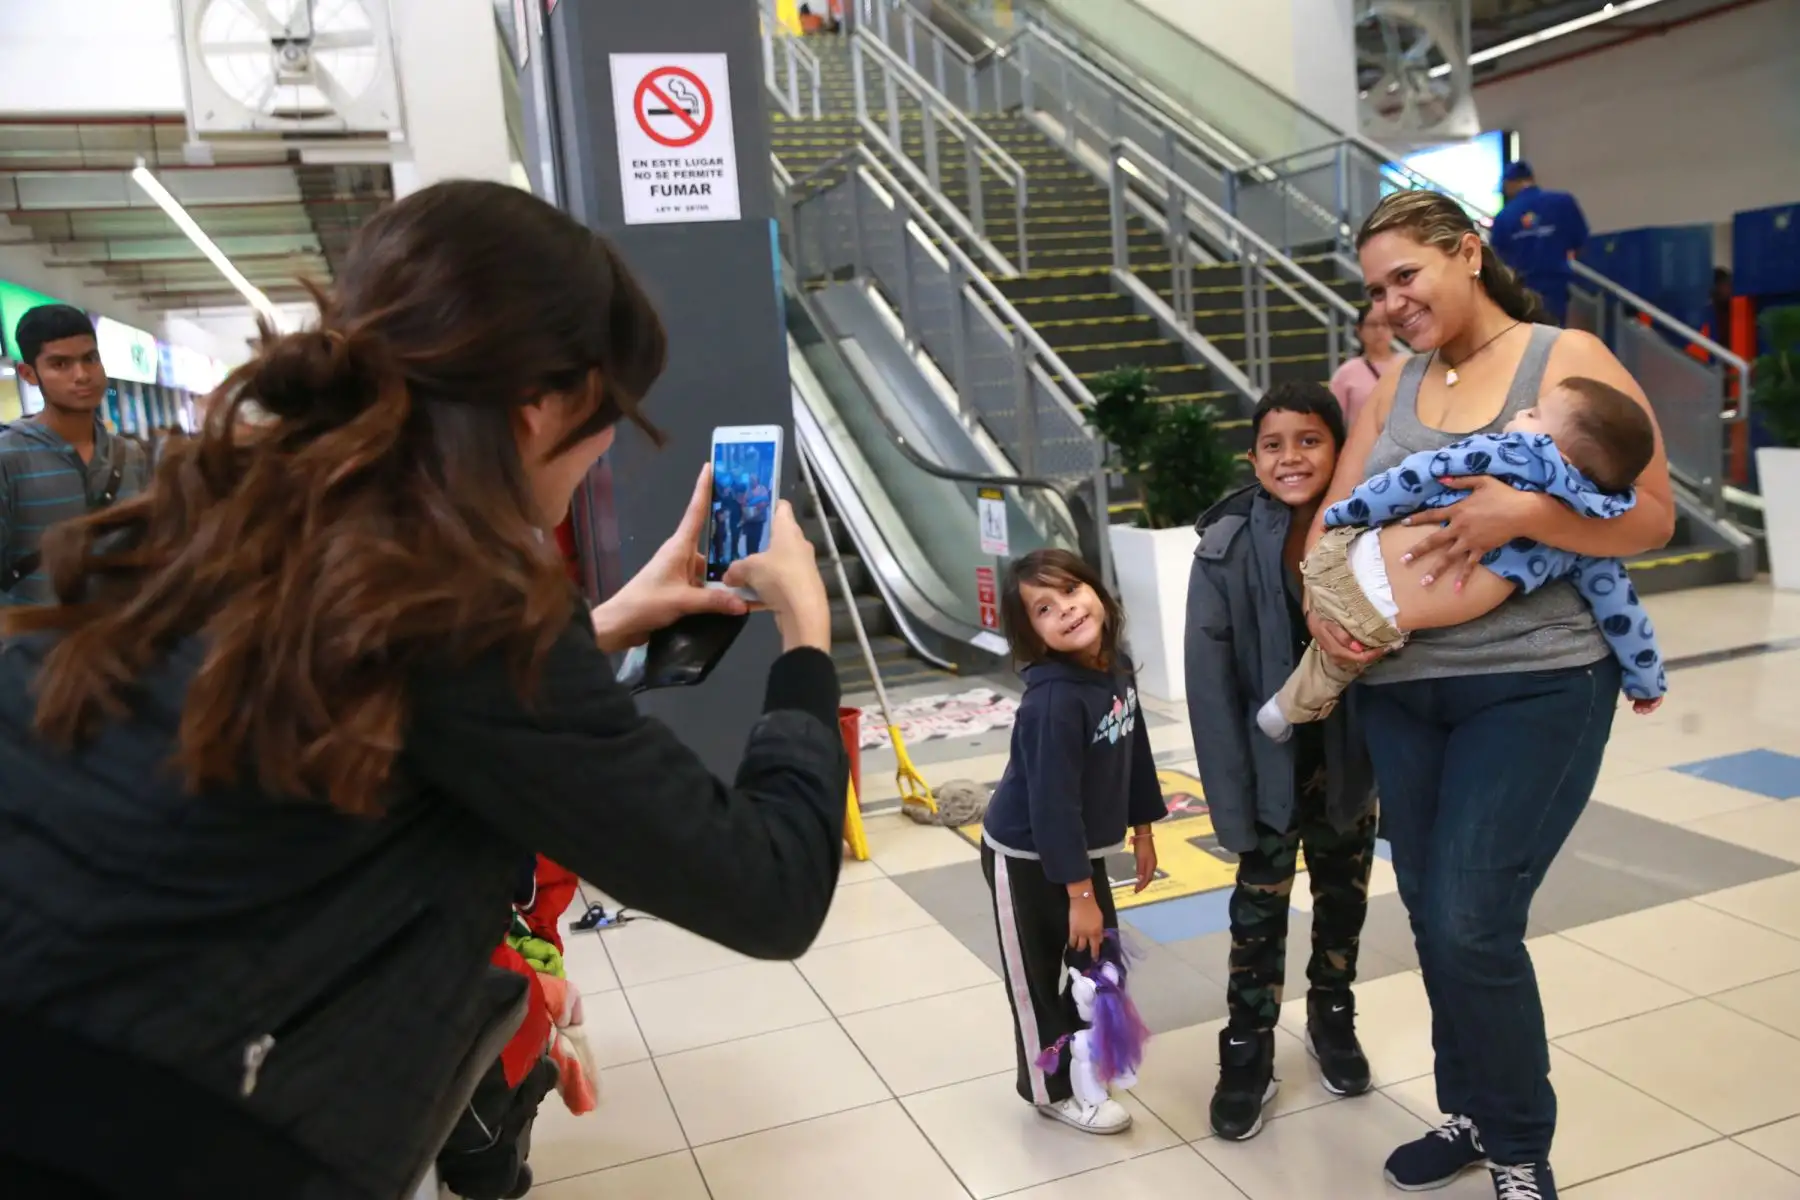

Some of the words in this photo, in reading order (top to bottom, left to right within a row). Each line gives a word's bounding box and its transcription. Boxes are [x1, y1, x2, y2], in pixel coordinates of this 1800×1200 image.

[632, 159, 648, 168] EN
[652, 158, 681, 168] ESTE
[684, 157, 724, 167] LUGAR
[634, 171, 652, 180] NO
[655, 170, 669, 180] SE
[673, 169, 724, 179] PERMITE
[650, 183, 712, 197] FUMAR
